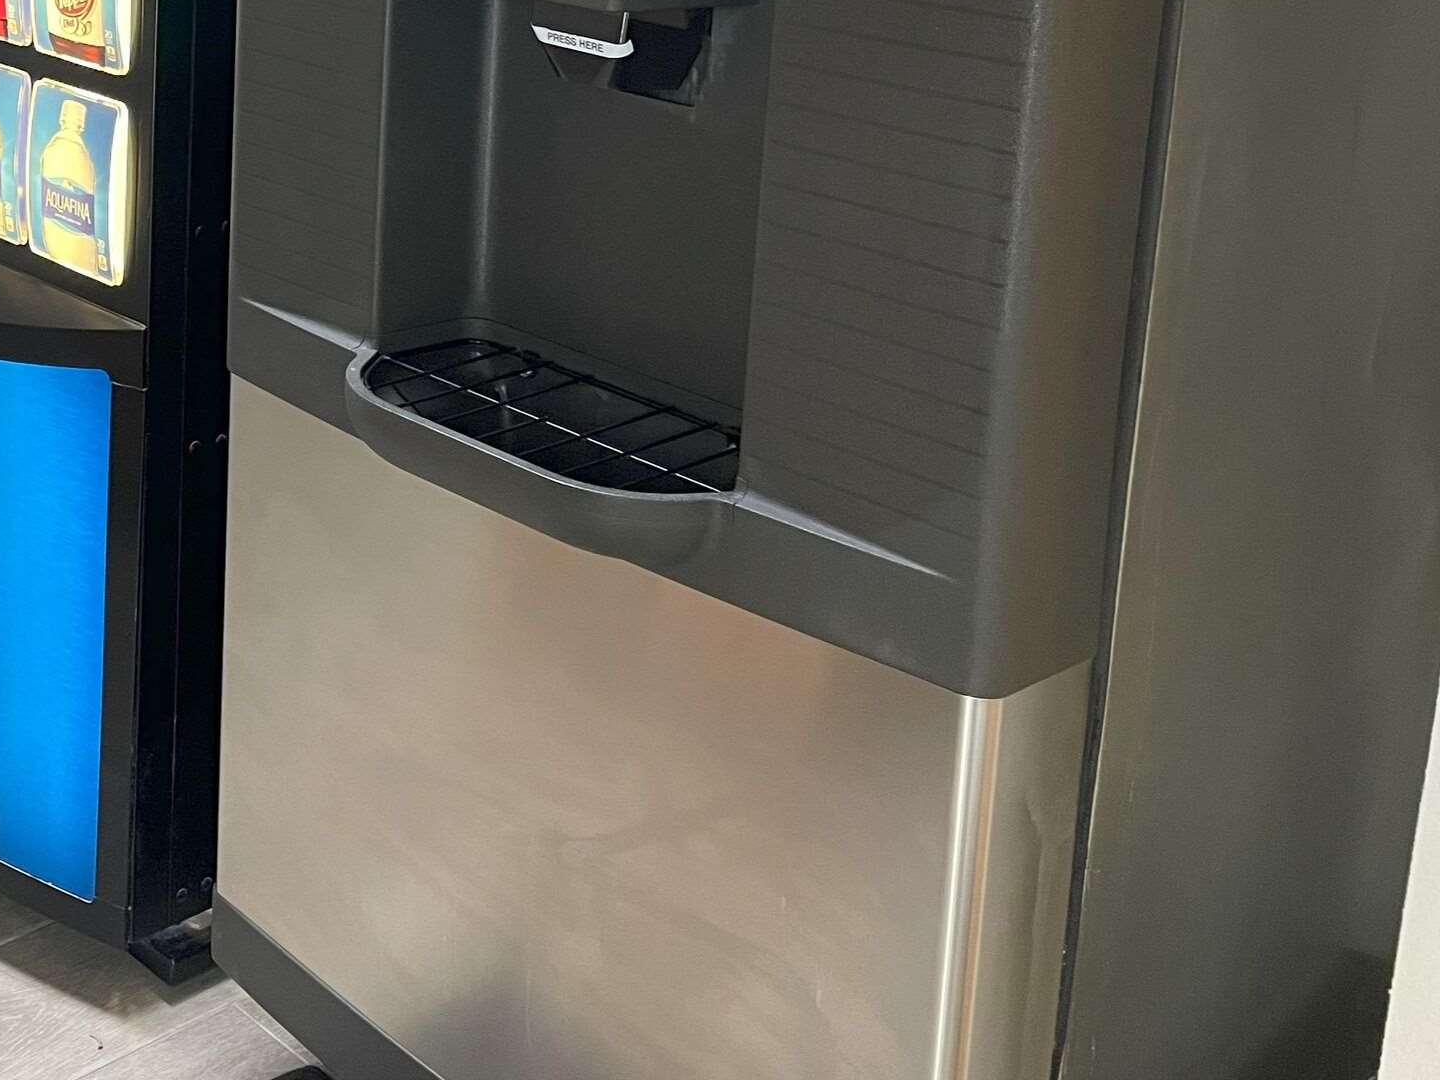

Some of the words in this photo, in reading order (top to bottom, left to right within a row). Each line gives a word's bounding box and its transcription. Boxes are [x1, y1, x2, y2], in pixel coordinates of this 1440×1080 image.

[547, 31, 577, 47] PRESS
[579, 39, 604, 53] HERE
[45, 188, 92, 224] AQUAFINA
